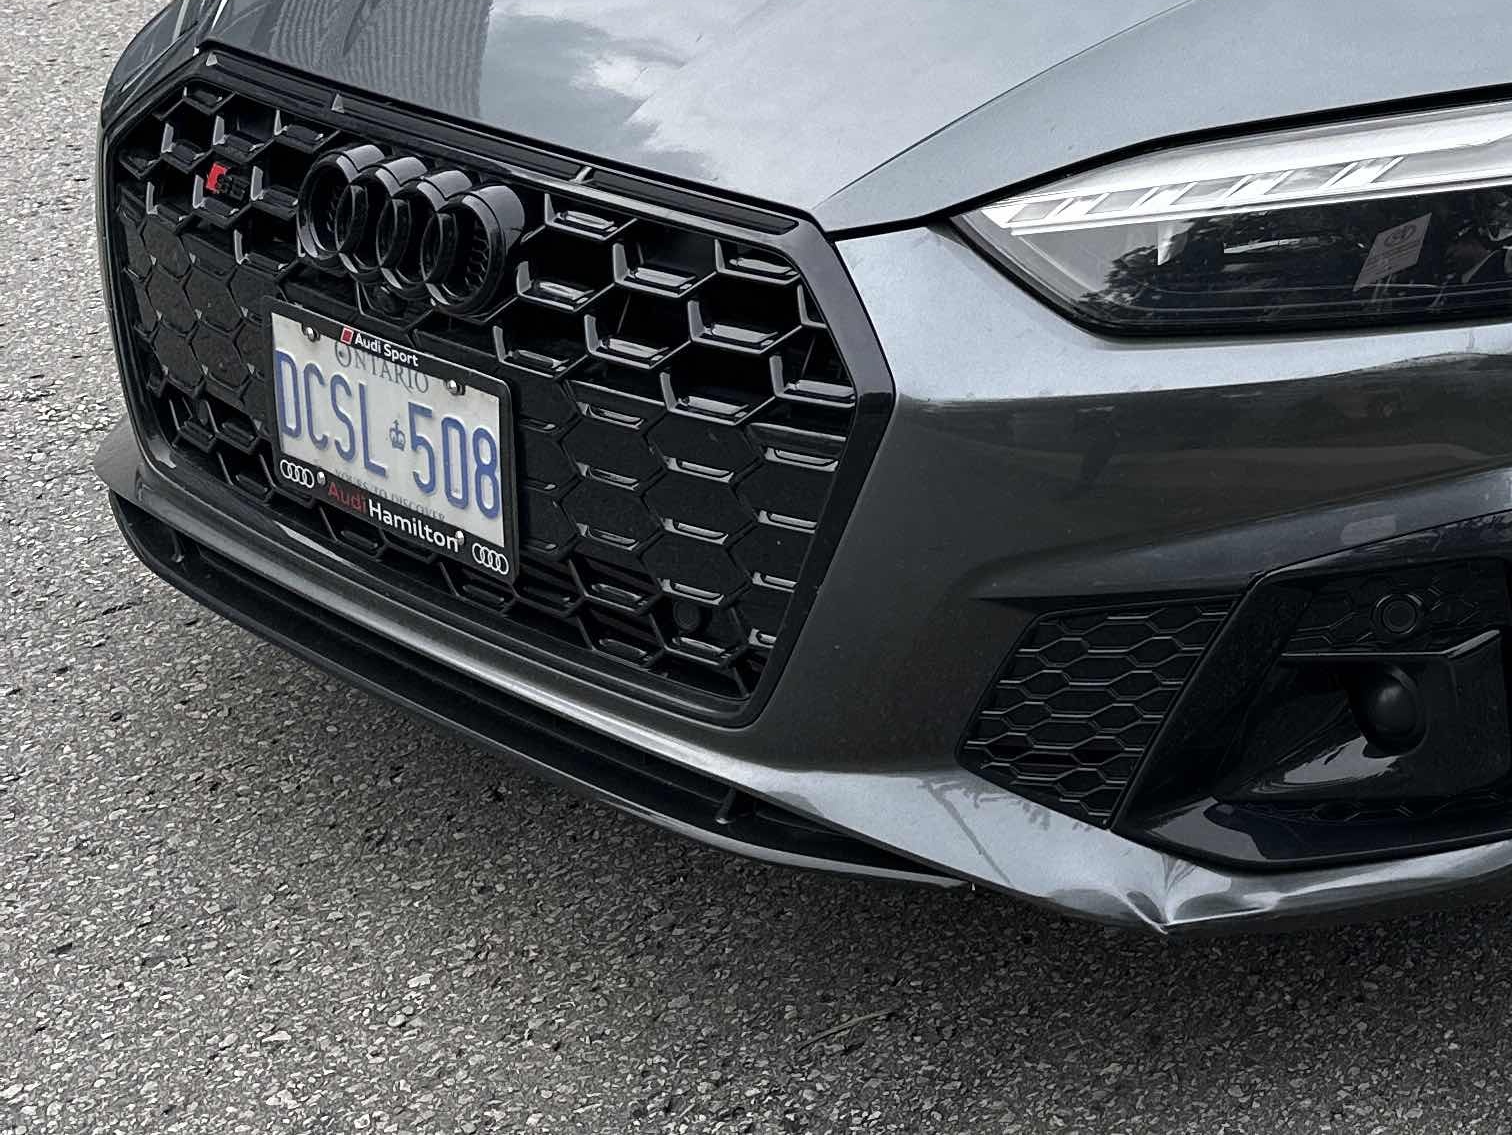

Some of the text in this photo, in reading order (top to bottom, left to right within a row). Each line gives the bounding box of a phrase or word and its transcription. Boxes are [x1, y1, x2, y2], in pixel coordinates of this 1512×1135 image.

[334, 340, 430, 394] ONTARIO
[354, 333, 419, 367] Audi Sport
[276, 350, 501, 519] DCSL 508
[327, 481, 460, 553] Audi Hamilton
